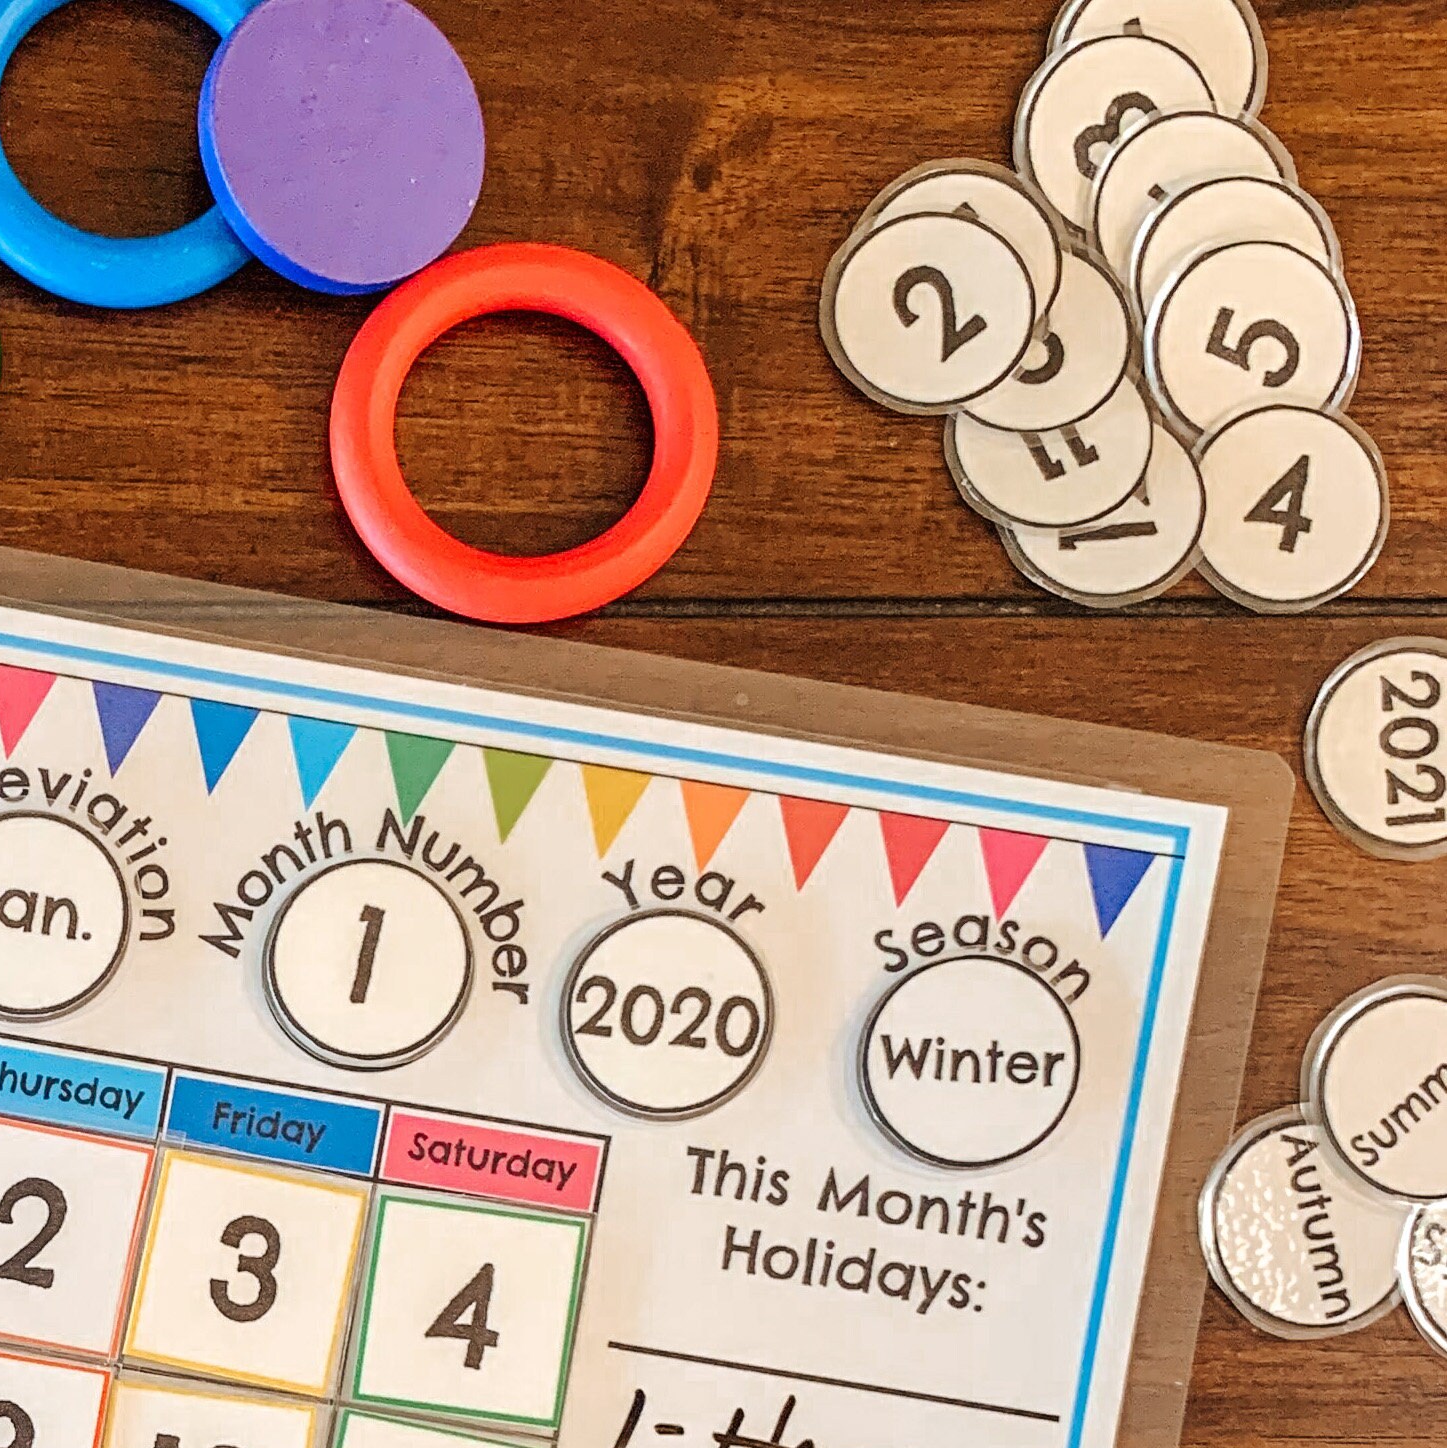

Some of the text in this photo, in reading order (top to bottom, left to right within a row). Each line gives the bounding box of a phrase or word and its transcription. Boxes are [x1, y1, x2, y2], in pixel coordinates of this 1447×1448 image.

[893, 265, 987, 363] 2
[1206, 307, 1299, 387] 5
[1244, 454, 1312, 553] 4
[1379, 670, 1447, 827] 2021
[198, 806, 529, 1005] Month Number
[601, 858, 766, 922] Year
[348, 904, 385, 1004] 1
[874, 913, 1091, 1006] Season
[574, 974, 761, 1059] 2020
[880, 1033, 1066, 1087] Winter
[212, 1102, 327, 1154] Friday
[407, 1131, 578, 1191] Saturday
[685, 1147, 1048, 1249] This Month's
[1280, 1134, 1352, 1320] Autumn
[209, 1215, 281, 1323] 3
[425, 1263, 499, 1370] 4
[721, 1224, 987, 1315] Holidays:
